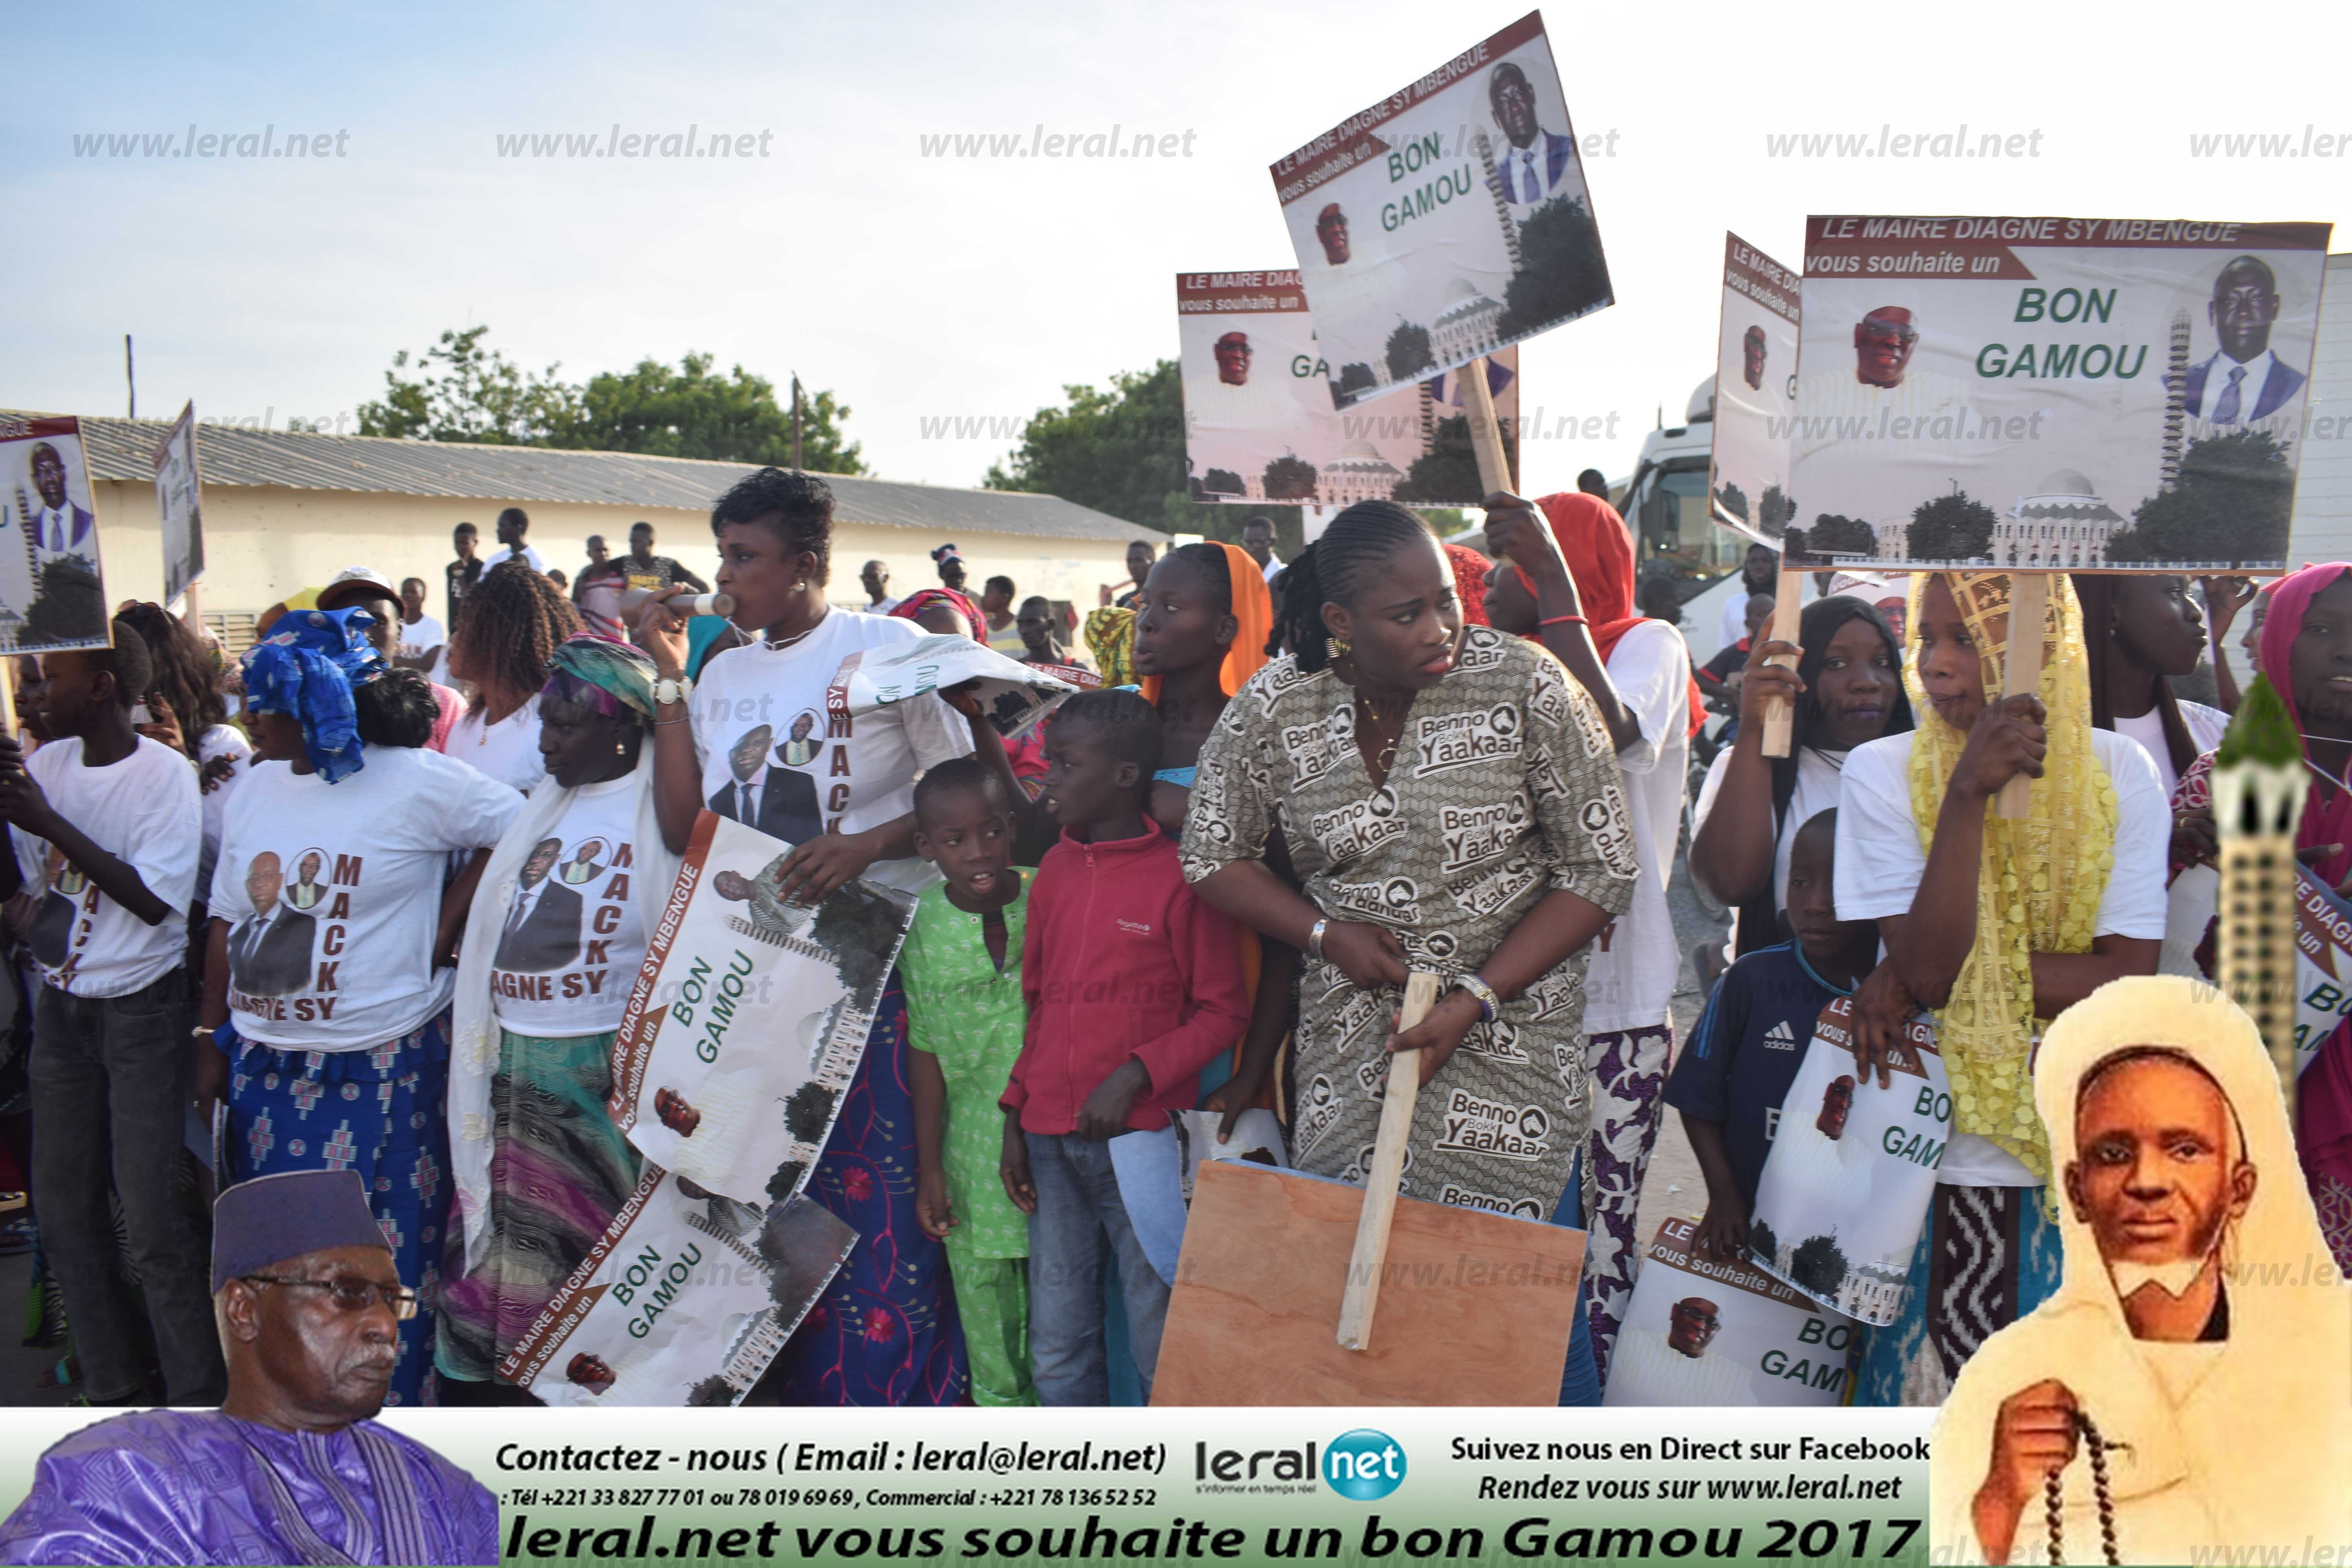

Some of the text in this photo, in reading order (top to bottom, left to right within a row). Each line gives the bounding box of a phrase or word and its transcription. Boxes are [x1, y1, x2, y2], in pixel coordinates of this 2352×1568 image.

[1275, 42, 1490, 176] LE MAIRE DIAGNE SY MBENGUE
[1278, 143, 1372, 203] vous souhaite un
[1388, 131, 1441, 183] BON
[1381, 163, 1471, 232] GAMOU
[1821, 218, 2242, 243] LE MAIRE DIAGNE SY MBENGUE
[1733, 243, 1749, 265] LE
[1749, 252, 1783, 286] MAIRE
[1805, 250, 2001, 274] vous souhaite un
[1186, 274, 1208, 289] LE
[1210, 272, 1262, 288] MAIRE
[1726, 269, 1799, 321] vous souhaite un
[1178, 294, 1299, 312] vous souhaite un
[2013, 287, 2118, 323] BON
[1975, 343, 2150, 379] GAMOU
[828, 688, 844, 710] SY
[1422, 714, 1486, 738] Benno
[1421, 728, 1523, 765] Yaakaar
[1314, 803, 1365, 838] Benno
[626, 976, 652, 1044] DIAGNE
[642, 949, 661, 976] SY
[653, 862, 699, 951] MBENGUE
[2299, 931, 2323, 955] un
[562, 969, 609, 999] SY
[671, 956, 713, 1028] BON
[294, 997, 338, 1022] SY
[696, 949, 754, 1065] GAMOU
[1828, 998, 1853, 1016] LE
[1763, 1040, 1796, 1052] adidas
[1816, 1021, 1847, 1043] vous
[627, 1042, 650, 1103] souhaite
[642, 1020, 658, 1044] un
[1452, 1093, 1516, 1124] Benno
[1467, 1118, 1498, 1132] Bokk
[1448, 1118, 1546, 1156] Yaakaar
[1443, 1187, 1510, 1213] Benno
[1663, 1220, 1693, 1241] LE
[499, 1355, 521, 1377] LE
[514, 1309, 555, 1357] MAIRE
[549, 1258, 597, 1313] DIAGNE
[591, 1236, 612, 1259] SY
[606, 1165, 664, 1239] MBENGUE
[611, 1243, 663, 1307] BON
[1649, 1243, 1688, 1267] vous
[1690, 1258, 1768, 1292] souhaite
[1770, 1283, 1795, 1301] un
[628, 1242, 702, 1339] GAMOU
[537, 1314, 579, 1362] souhaite
[575, 1295, 593, 1315] un
